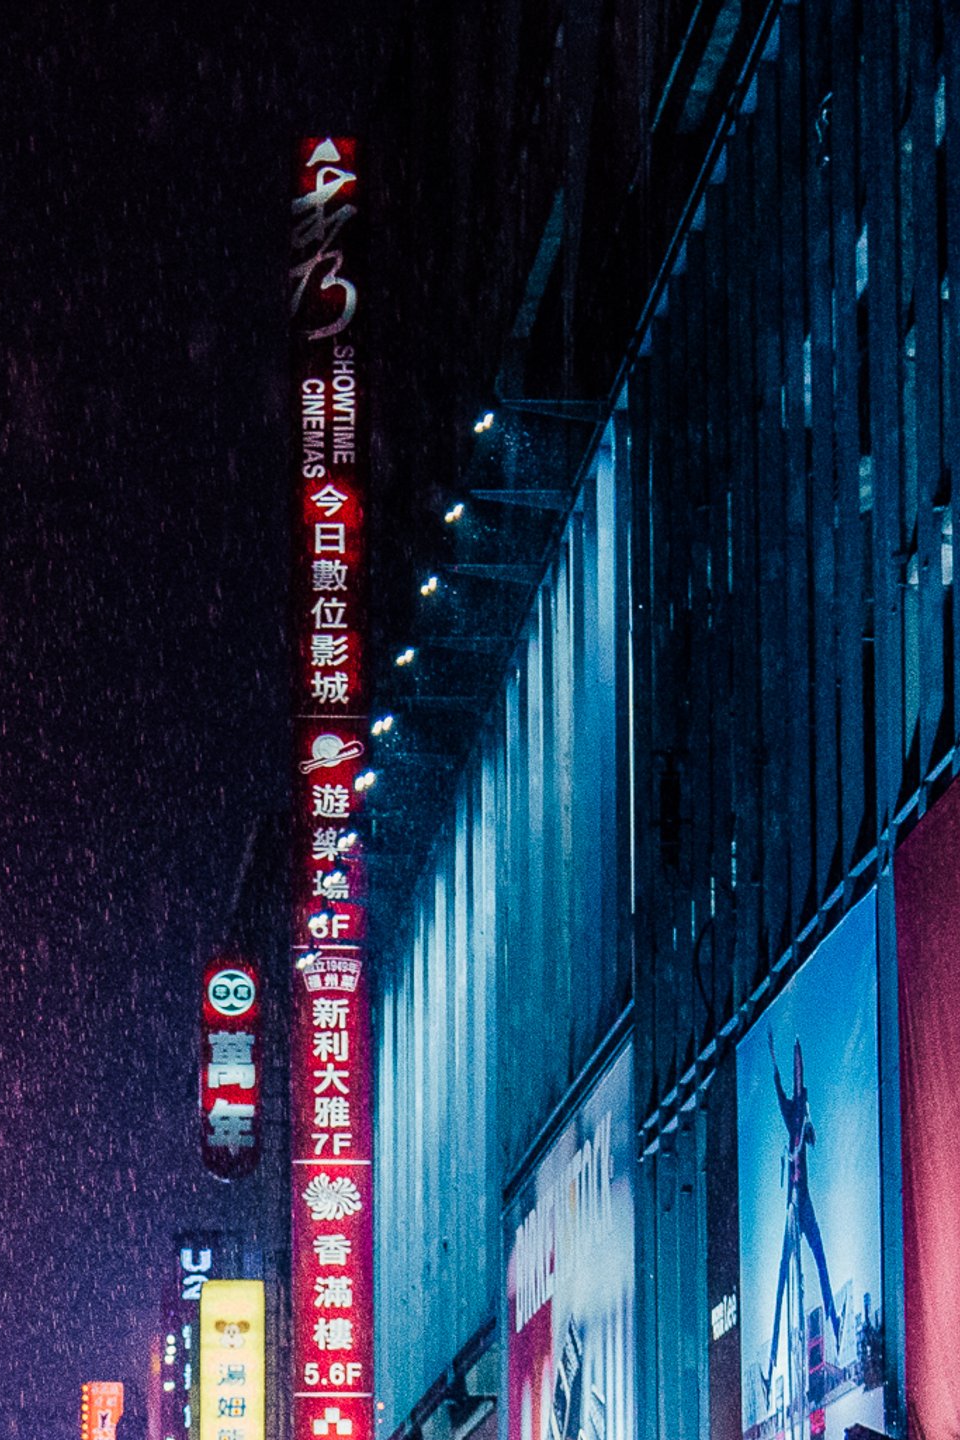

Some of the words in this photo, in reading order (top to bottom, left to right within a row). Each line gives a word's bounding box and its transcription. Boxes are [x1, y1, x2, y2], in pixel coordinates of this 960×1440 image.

[301, 379, 325, 479] CINEMAS
[333, 346, 356, 464] SHOWTIME
[311, 484, 349, 704] 今日數位影城
[312, 784, 350, 899] 遊樂場
[313, 997, 351, 1127] 新利大雅
[311, 1133, 352, 1155] 7F
[313, 1233, 353, 1350] 香滿樓
[303, 1363, 363, 1386] 5.6F
